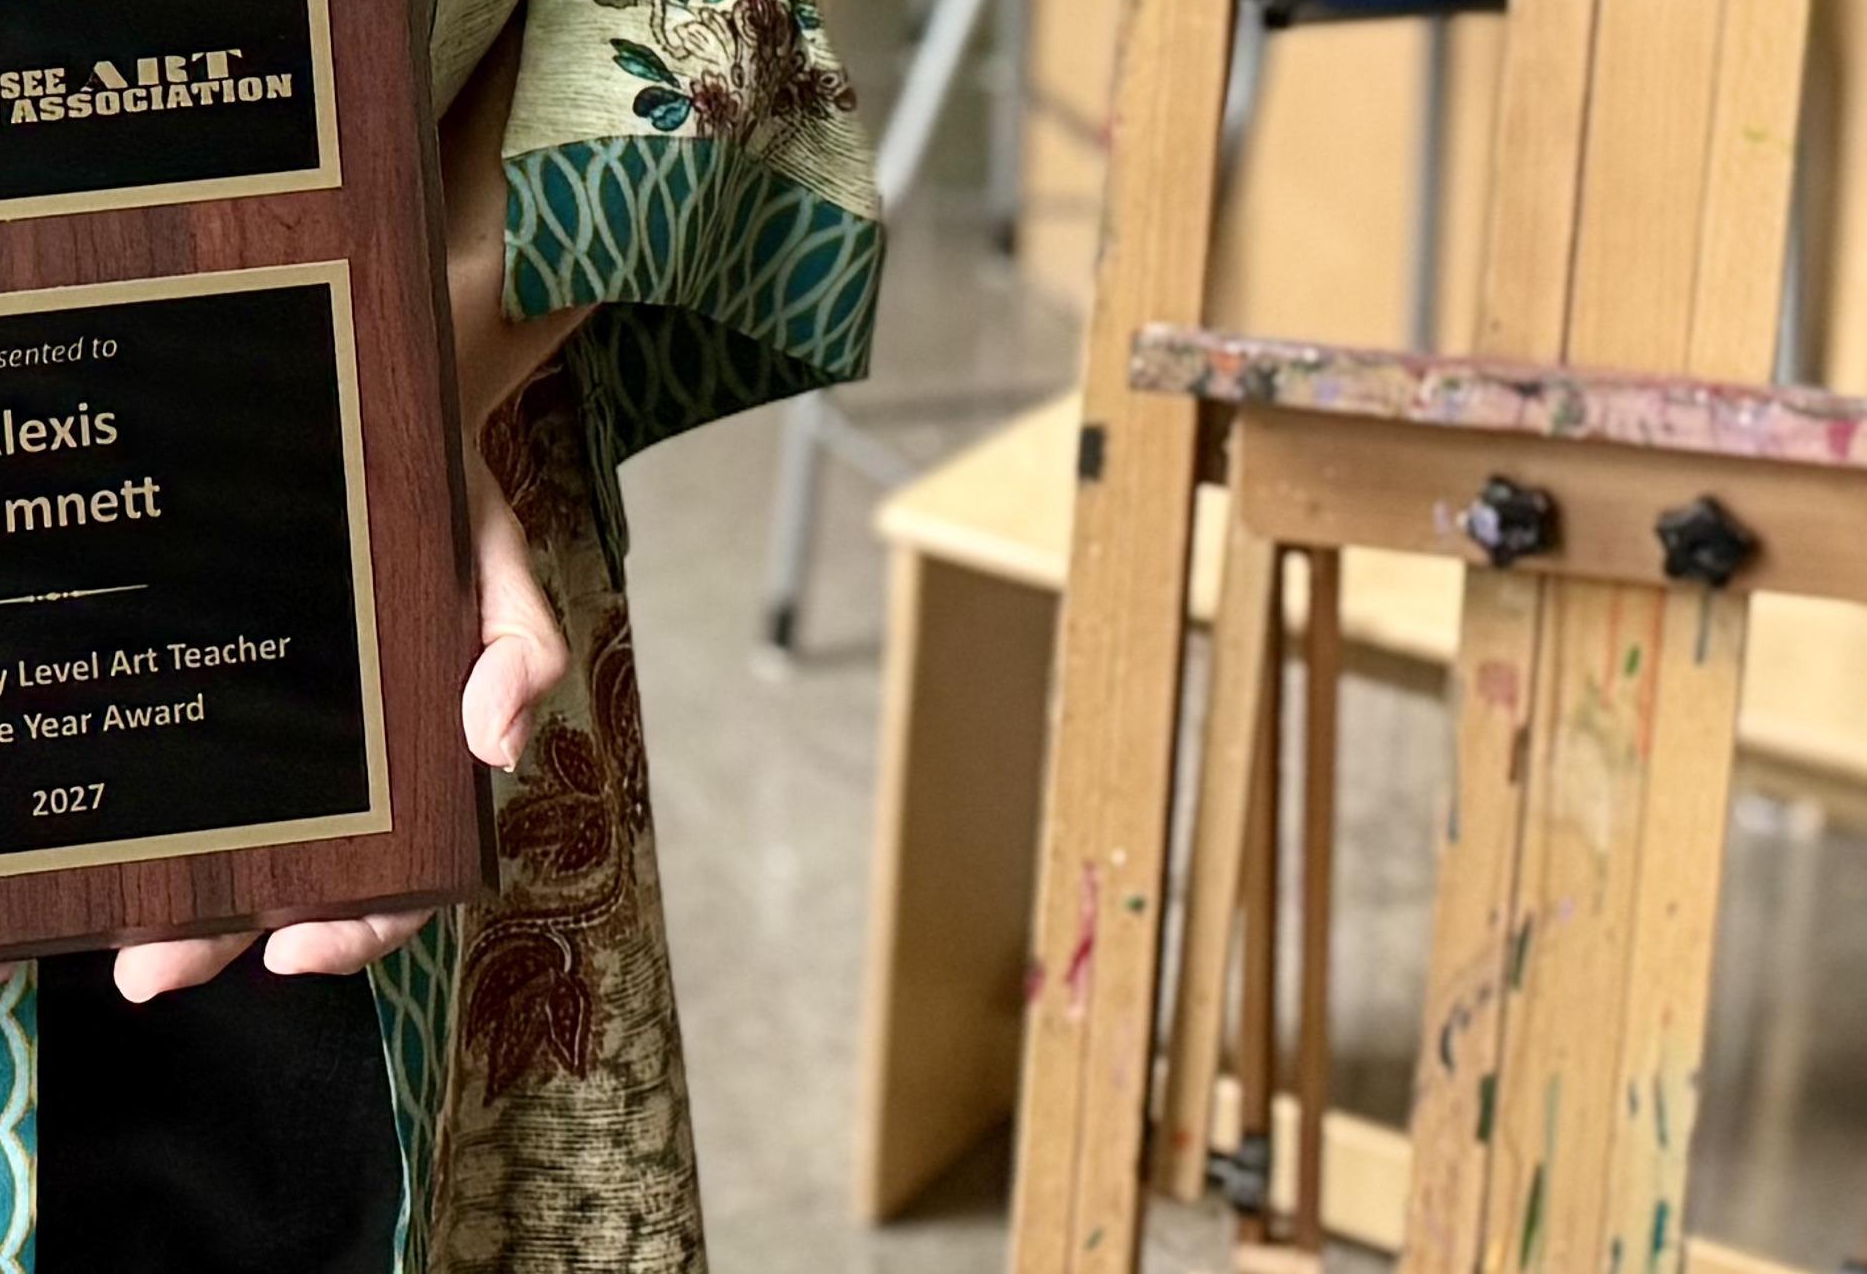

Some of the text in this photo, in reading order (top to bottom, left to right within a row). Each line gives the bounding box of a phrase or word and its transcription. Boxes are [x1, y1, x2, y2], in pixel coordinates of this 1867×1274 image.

[80, 48, 243, 92] ART
[10, 73, 292, 124] ASSOCIATION
[93, 338, 118, 360] to
[18, 651, 100, 687] Level
[109, 647, 159, 678] Art
[166, 634, 292, 671] Teacher
[22, 712, 92, 740] Year
[102, 693, 205, 732] Award
[31, 782, 105, 817] 2027
